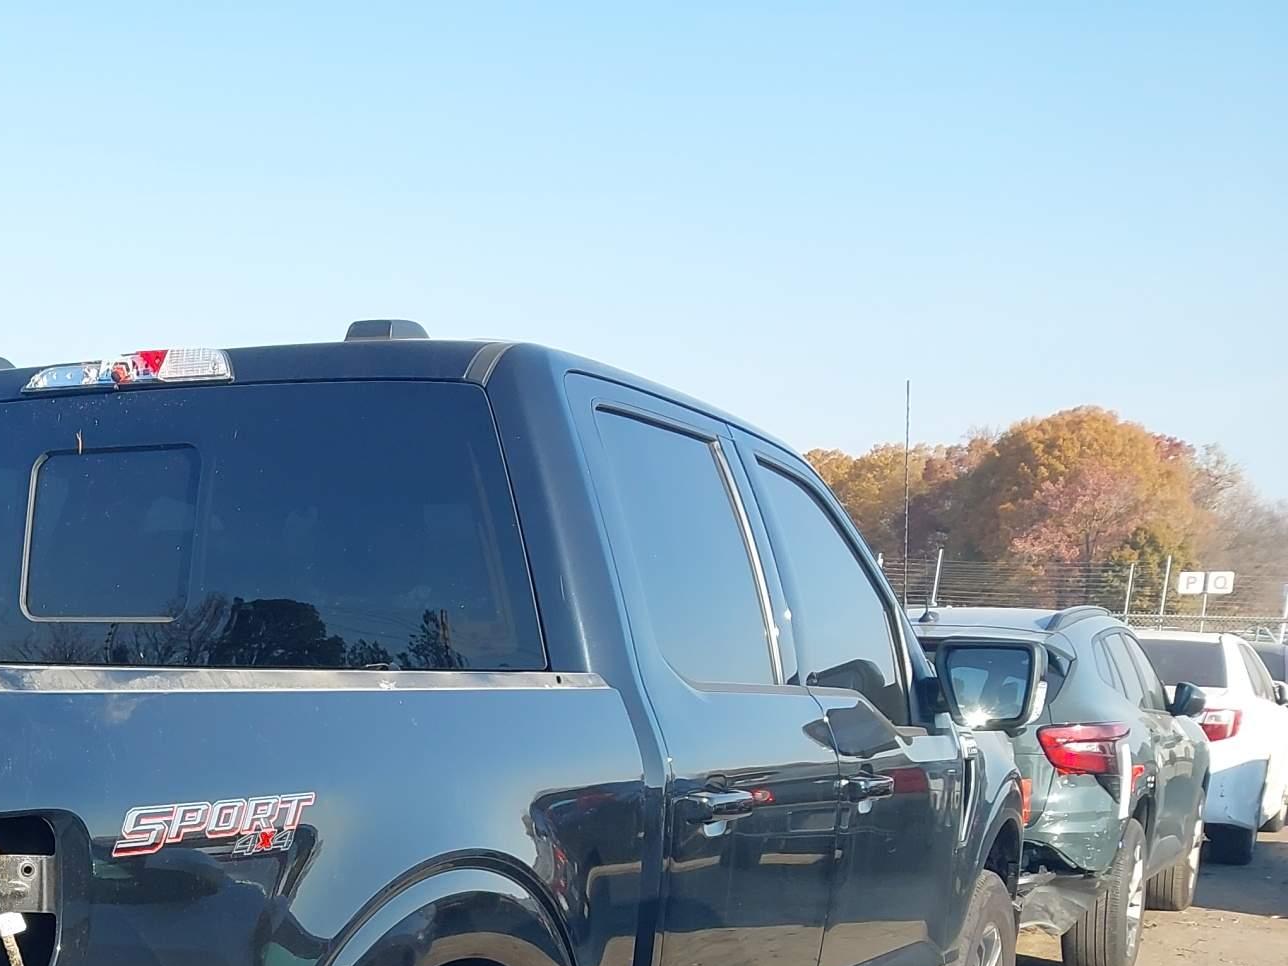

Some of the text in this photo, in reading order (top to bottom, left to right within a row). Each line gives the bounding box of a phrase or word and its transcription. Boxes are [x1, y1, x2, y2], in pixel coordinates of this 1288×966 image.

[1185, 575, 1198, 590] P
[1213, 575, 1229, 590] Q
[112, 791, 316, 857] SPORT
